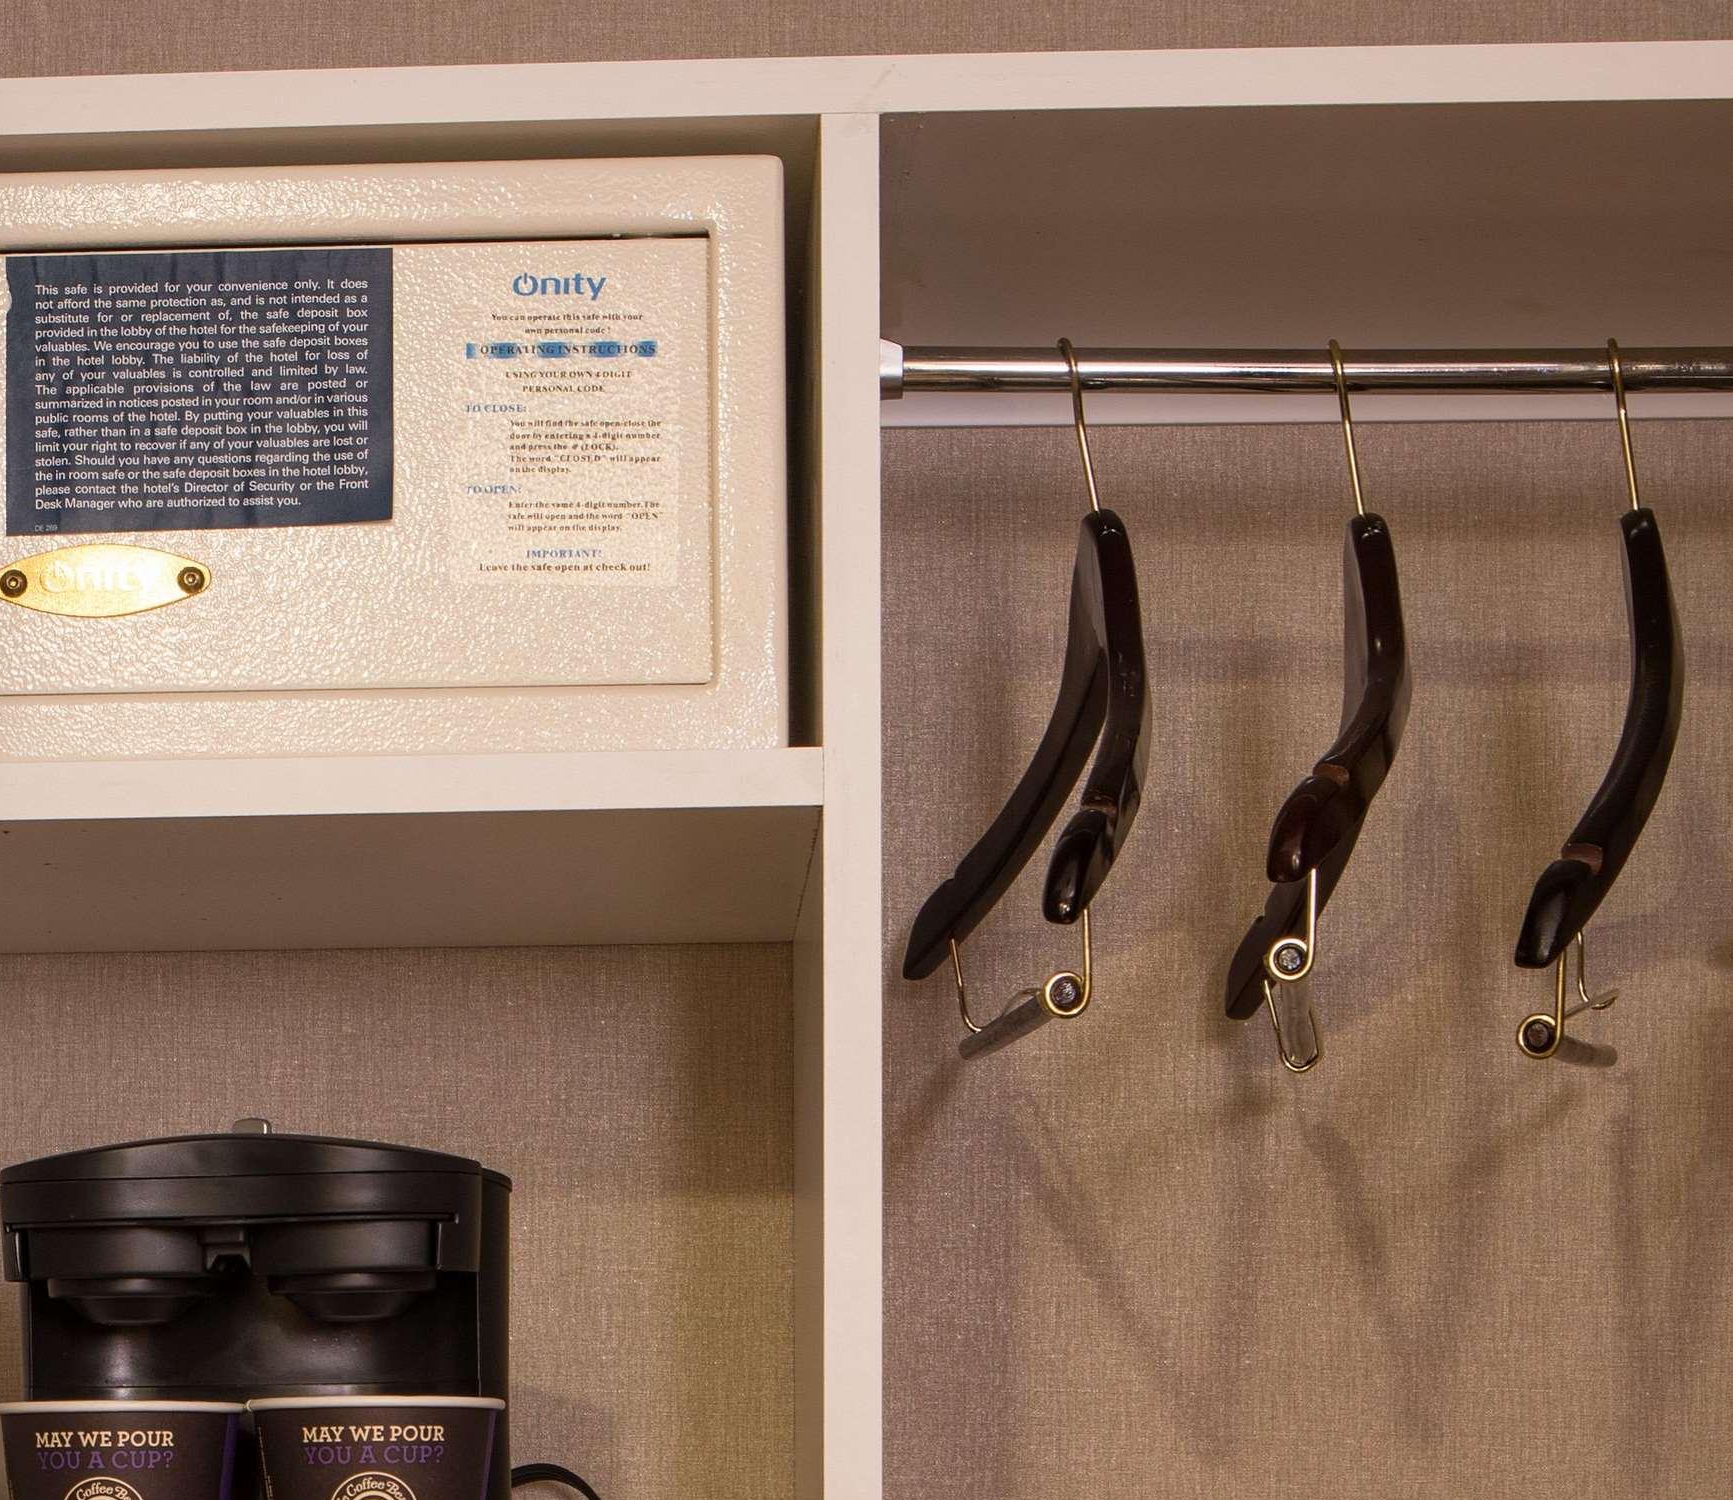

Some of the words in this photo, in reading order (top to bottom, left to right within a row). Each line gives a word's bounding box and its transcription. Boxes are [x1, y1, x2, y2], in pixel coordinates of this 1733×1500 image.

[34, 284, 59, 295] This
[64, 284, 88, 296] safe
[93, 284, 103, 294] is
[107, 283, 158, 296] provided
[164, 281, 181, 292] for
[186, 283, 213, 294] your
[218, 279, 289, 292] convenience
[294, 279, 321, 291] only.
[327, 279, 335, 289] It
[340, 278, 369, 289] does
[512, 272, 607, 300] Onity
[35, 299, 54, 310] not
[57, 298, 90, 309] afford
[94, 298, 112, 308] the
[115, 300, 147, 308] same
[150, 296, 207, 309] protection
[210, 295, 226, 307] as,
[230, 295, 252, 305] and
[255, 295, 265, 305] is
[269, 295, 288, 305] not
[291, 293, 340, 304] intended
[344, 295, 357, 303] as
[361, 295, 368, 303] a
[34, 313, 90, 324] substitute
[97, 312, 114, 323] for
[120, 314, 134, 322] or
[141, 308, 211, 323] replacement
[218, 310, 232, 321] of,
[240, 309, 259, 320] the
[266, 308, 290, 319] safe
[296, 307, 339, 319] deposit
[346, 305, 370, 317] box
[35, 327, 84, 340] provided
[87, 326, 98, 337] in
[100, 326, 119, 336] the
[120, 326, 152, 338] lobby
[154, 325, 167, 336] of
[168, 325, 187, 335] the
[189, 324, 217, 335] hotel
[220, 324, 237, 334] for
[238, 324, 257, 334] the
[259, 321, 325, 335] safekeeping
[328, 321, 340, 332] of
[341, 324, 369, 333] your
[35, 341, 90, 352] valuables.
[93, 340, 113, 351] We
[115, 342, 175, 353] encourage
[178, 341, 199, 351] you
[203, 340, 215, 349] to
[218, 338, 238, 349] use
[241, 338, 260, 348] the
[262, 337, 287, 348] safe
[289, 336, 331, 349] deposit
[334, 335, 369, 346] boxes
[481, 344, 558, 354] OPERATING
[559, 344, 655, 354] INSTRUCTIONS
[485, 404, 527, 412] CLOSE:
[479, 563, 509, 572] Leave
[511, 563, 528, 572] the
[531, 563, 552, 572] safe
[554, 563, 580, 572] open
[583, 563, 593, 572] at
[595, 563, 627, 572] check
[35, 1432, 73, 1448] MAY
[77, 1431, 112, 1447] WE
[117, 1430, 174, 1447] POUR
[302, 1426, 345, 1443] MAY
[349, 1426, 384, 1442] WE
[389, 1425, 445, 1442] POUR
[37, 1451, 80, 1469] YOU
[88, 1451, 106, 1469] A
[112, 1450, 174, 1468] CUP?
[305, 1446, 351, 1464] YOU
[359, 1445, 377, 1464] A
[383, 1445, 444, 1464] CUP?
[347, 1477, 385, 1497] Coffee
